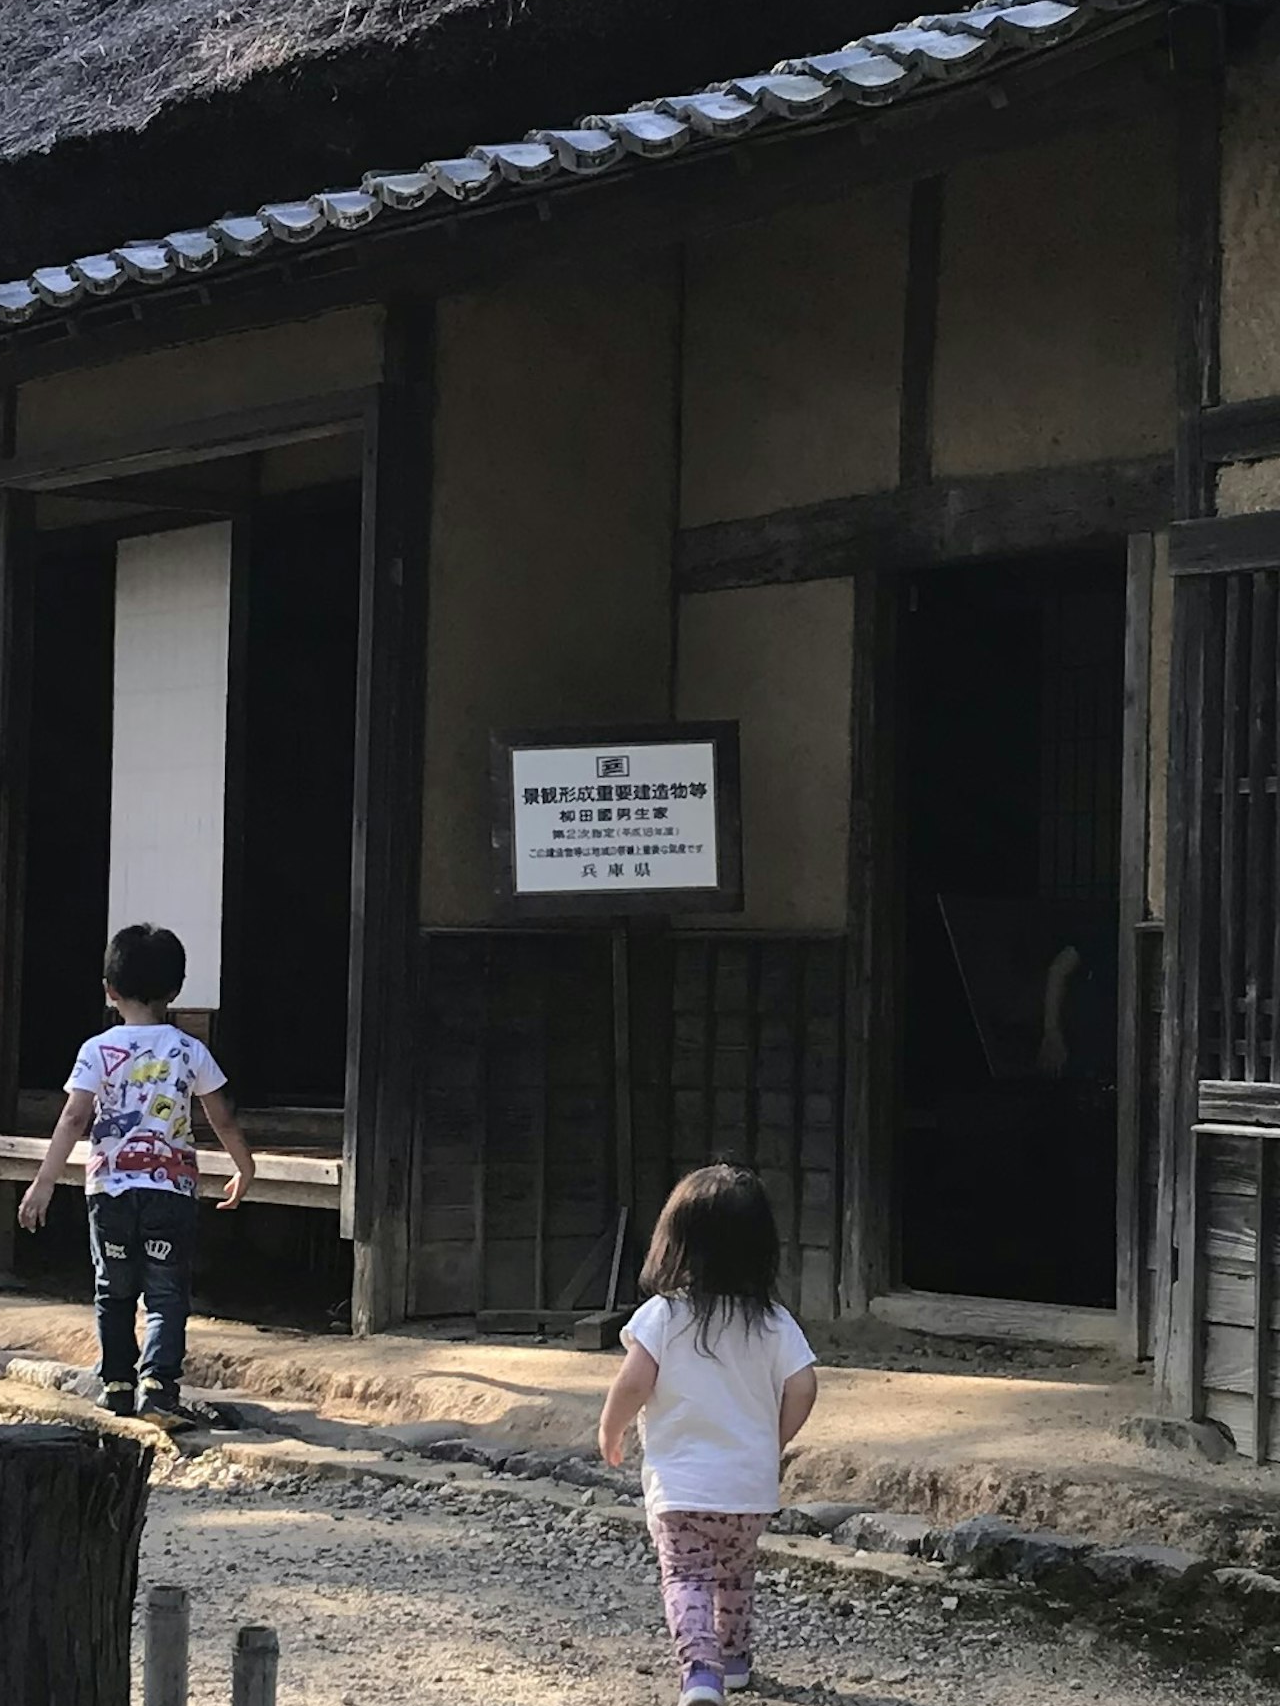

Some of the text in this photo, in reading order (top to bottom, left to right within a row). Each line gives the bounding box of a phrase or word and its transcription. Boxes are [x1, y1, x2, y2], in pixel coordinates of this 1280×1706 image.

[522, 782, 708, 806] 景観形成重要建造物等
[559, 806, 669, 823] 柳田國男生家
[580, 861, 651, 878] 兵庫県
